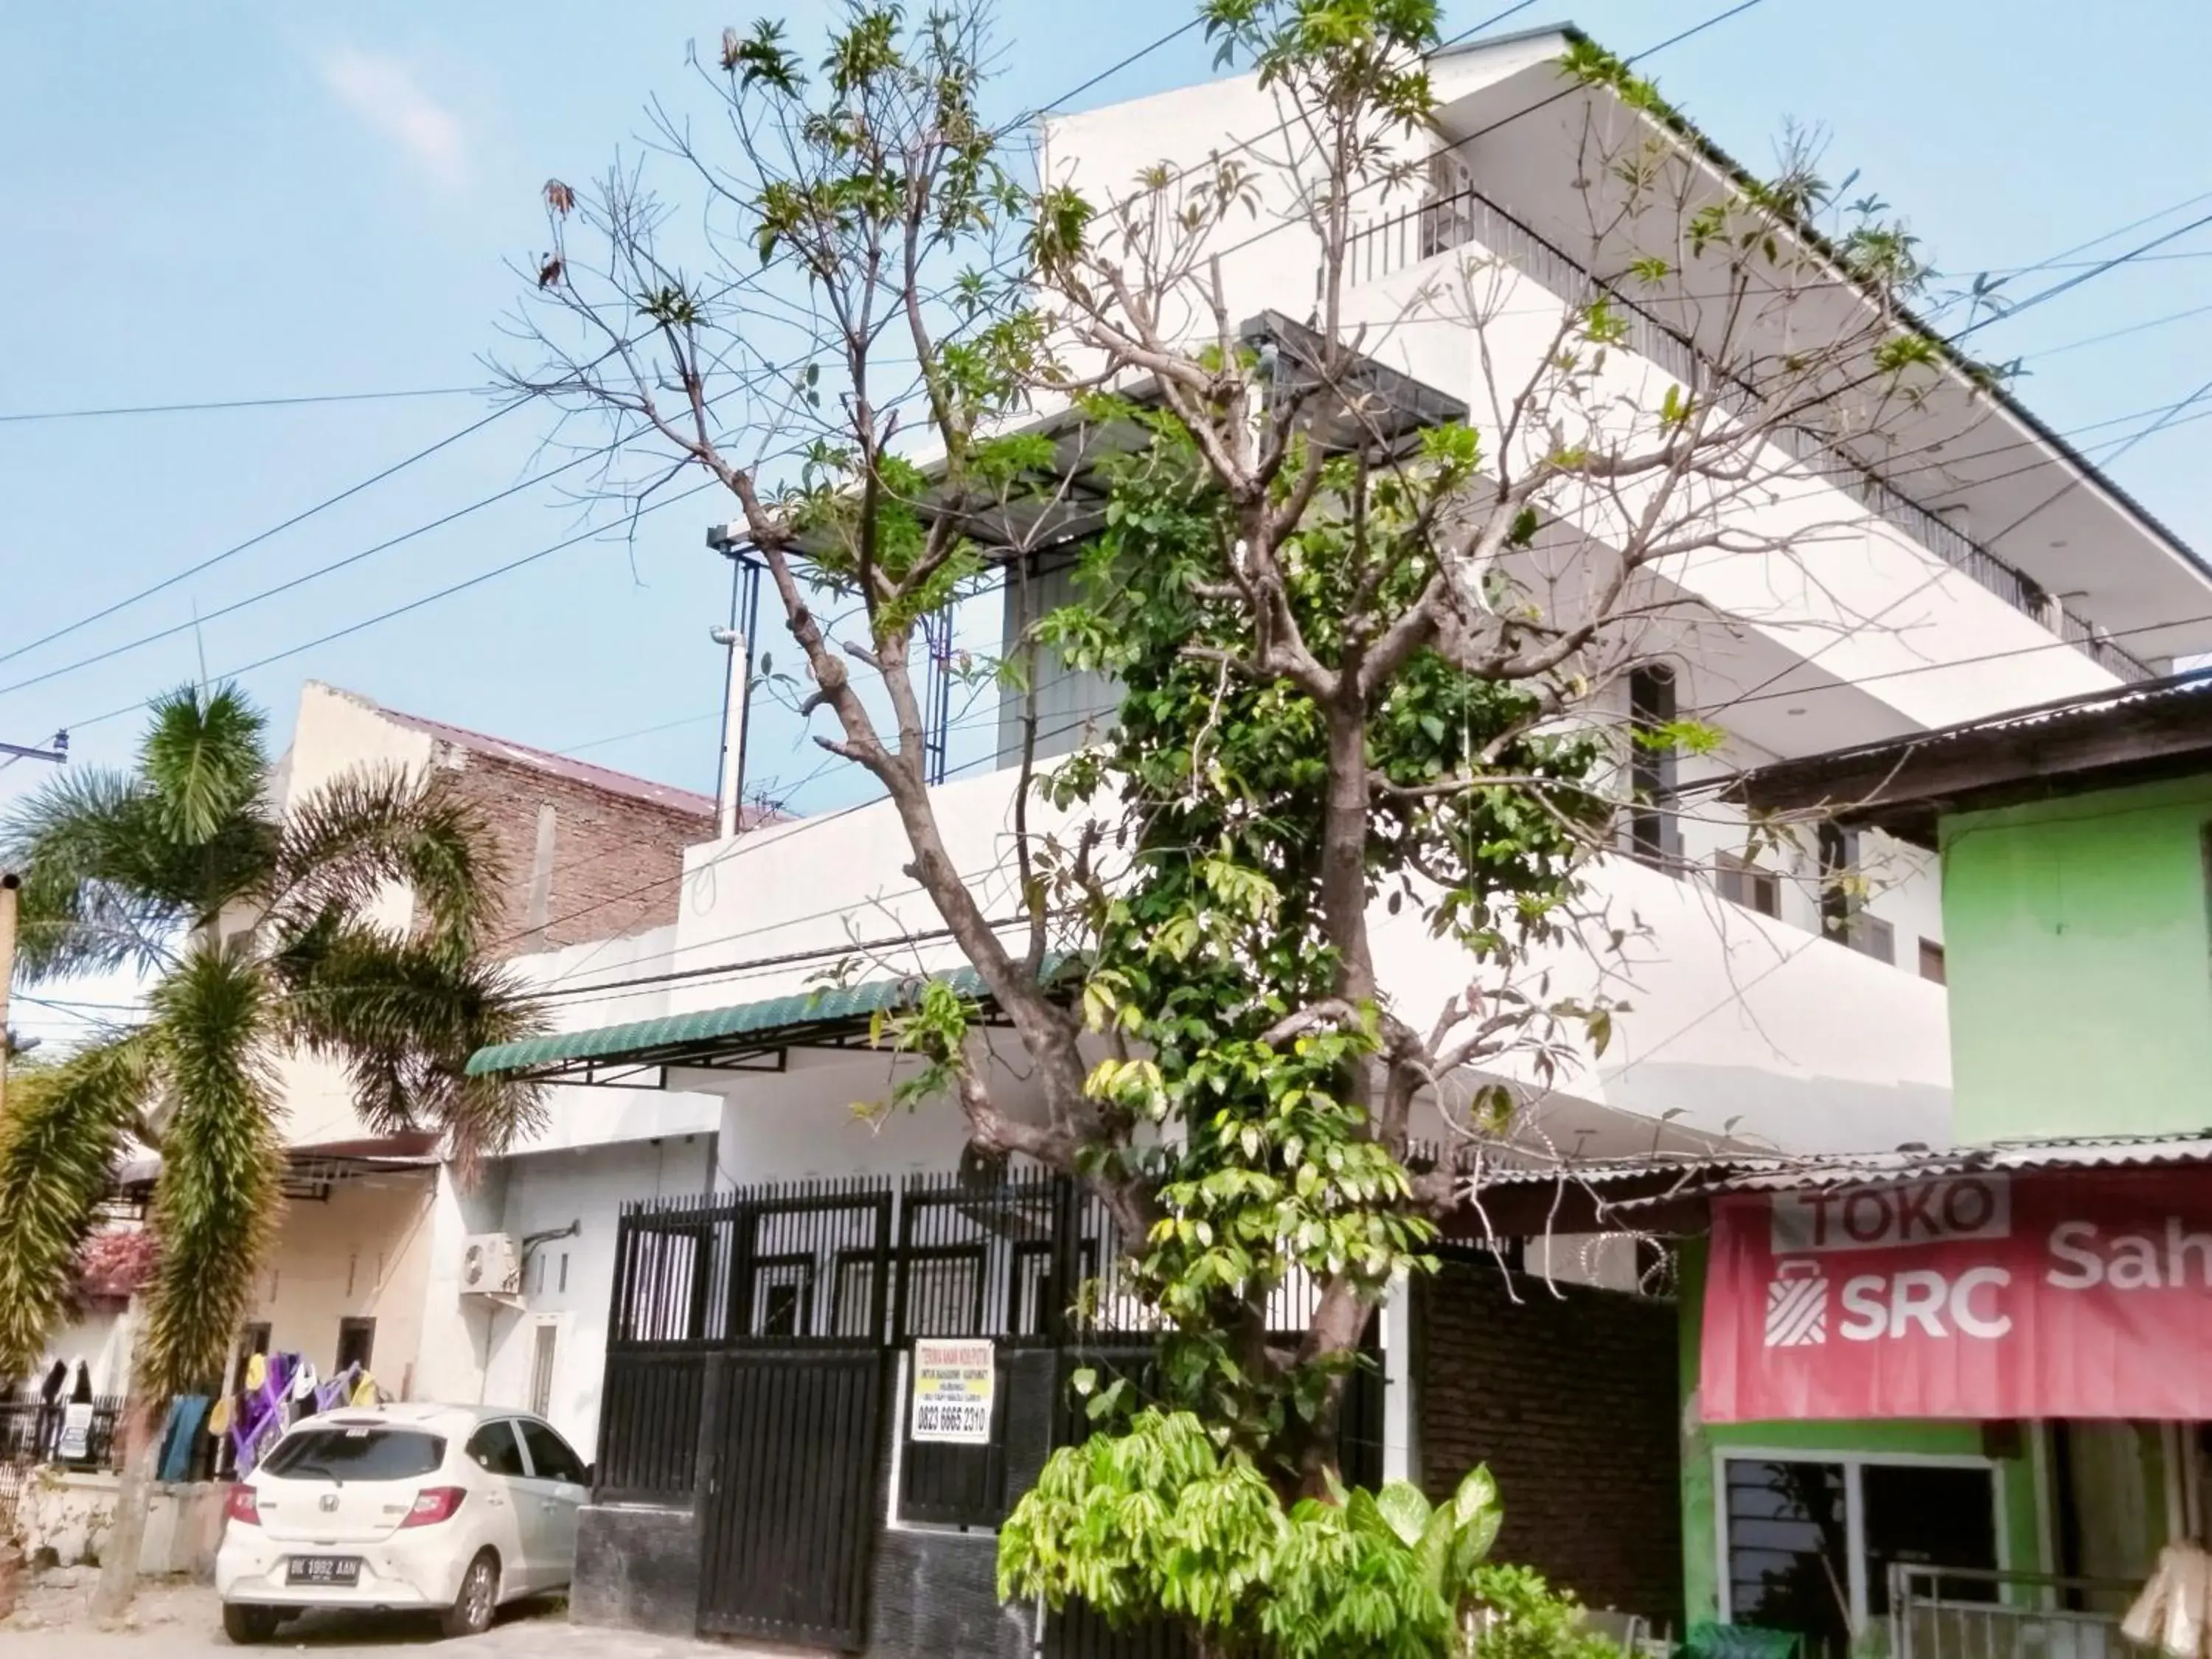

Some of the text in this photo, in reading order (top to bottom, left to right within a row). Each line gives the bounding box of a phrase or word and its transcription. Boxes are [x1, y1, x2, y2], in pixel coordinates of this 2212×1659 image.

[1798, 1177, 1994, 1246] TOKO
[2046, 1217, 2212, 1289] Sah
[1839, 1266, 2012, 1340] SRC
[918, 1405, 939, 1430] 0823
[964, 1407, 986, 1431] 2310
